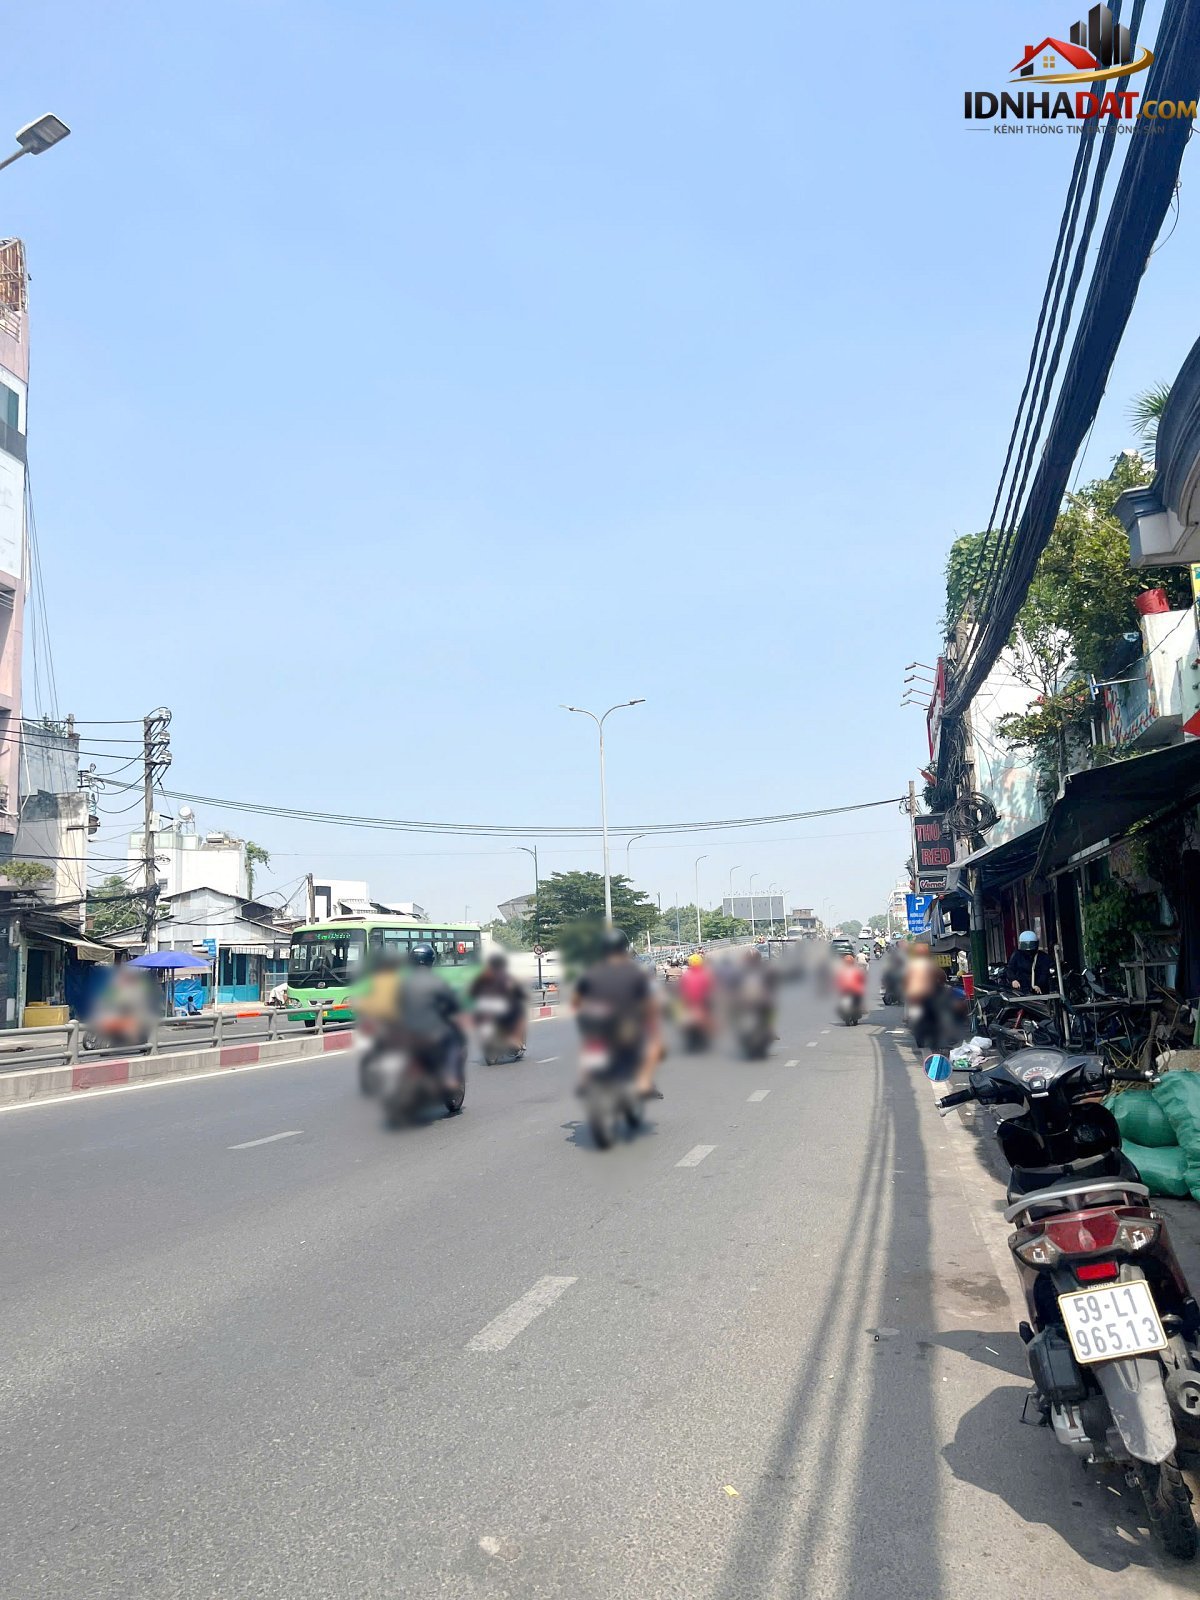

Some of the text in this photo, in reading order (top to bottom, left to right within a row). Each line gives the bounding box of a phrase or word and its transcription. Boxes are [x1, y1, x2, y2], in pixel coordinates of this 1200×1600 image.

[921, 848, 951, 866] RED
[1087, 1282, 1114, 1290] HONDA
[1073, 1288, 1138, 1324] 59-L1
[1075, 1317, 1159, 1356] 965.13
